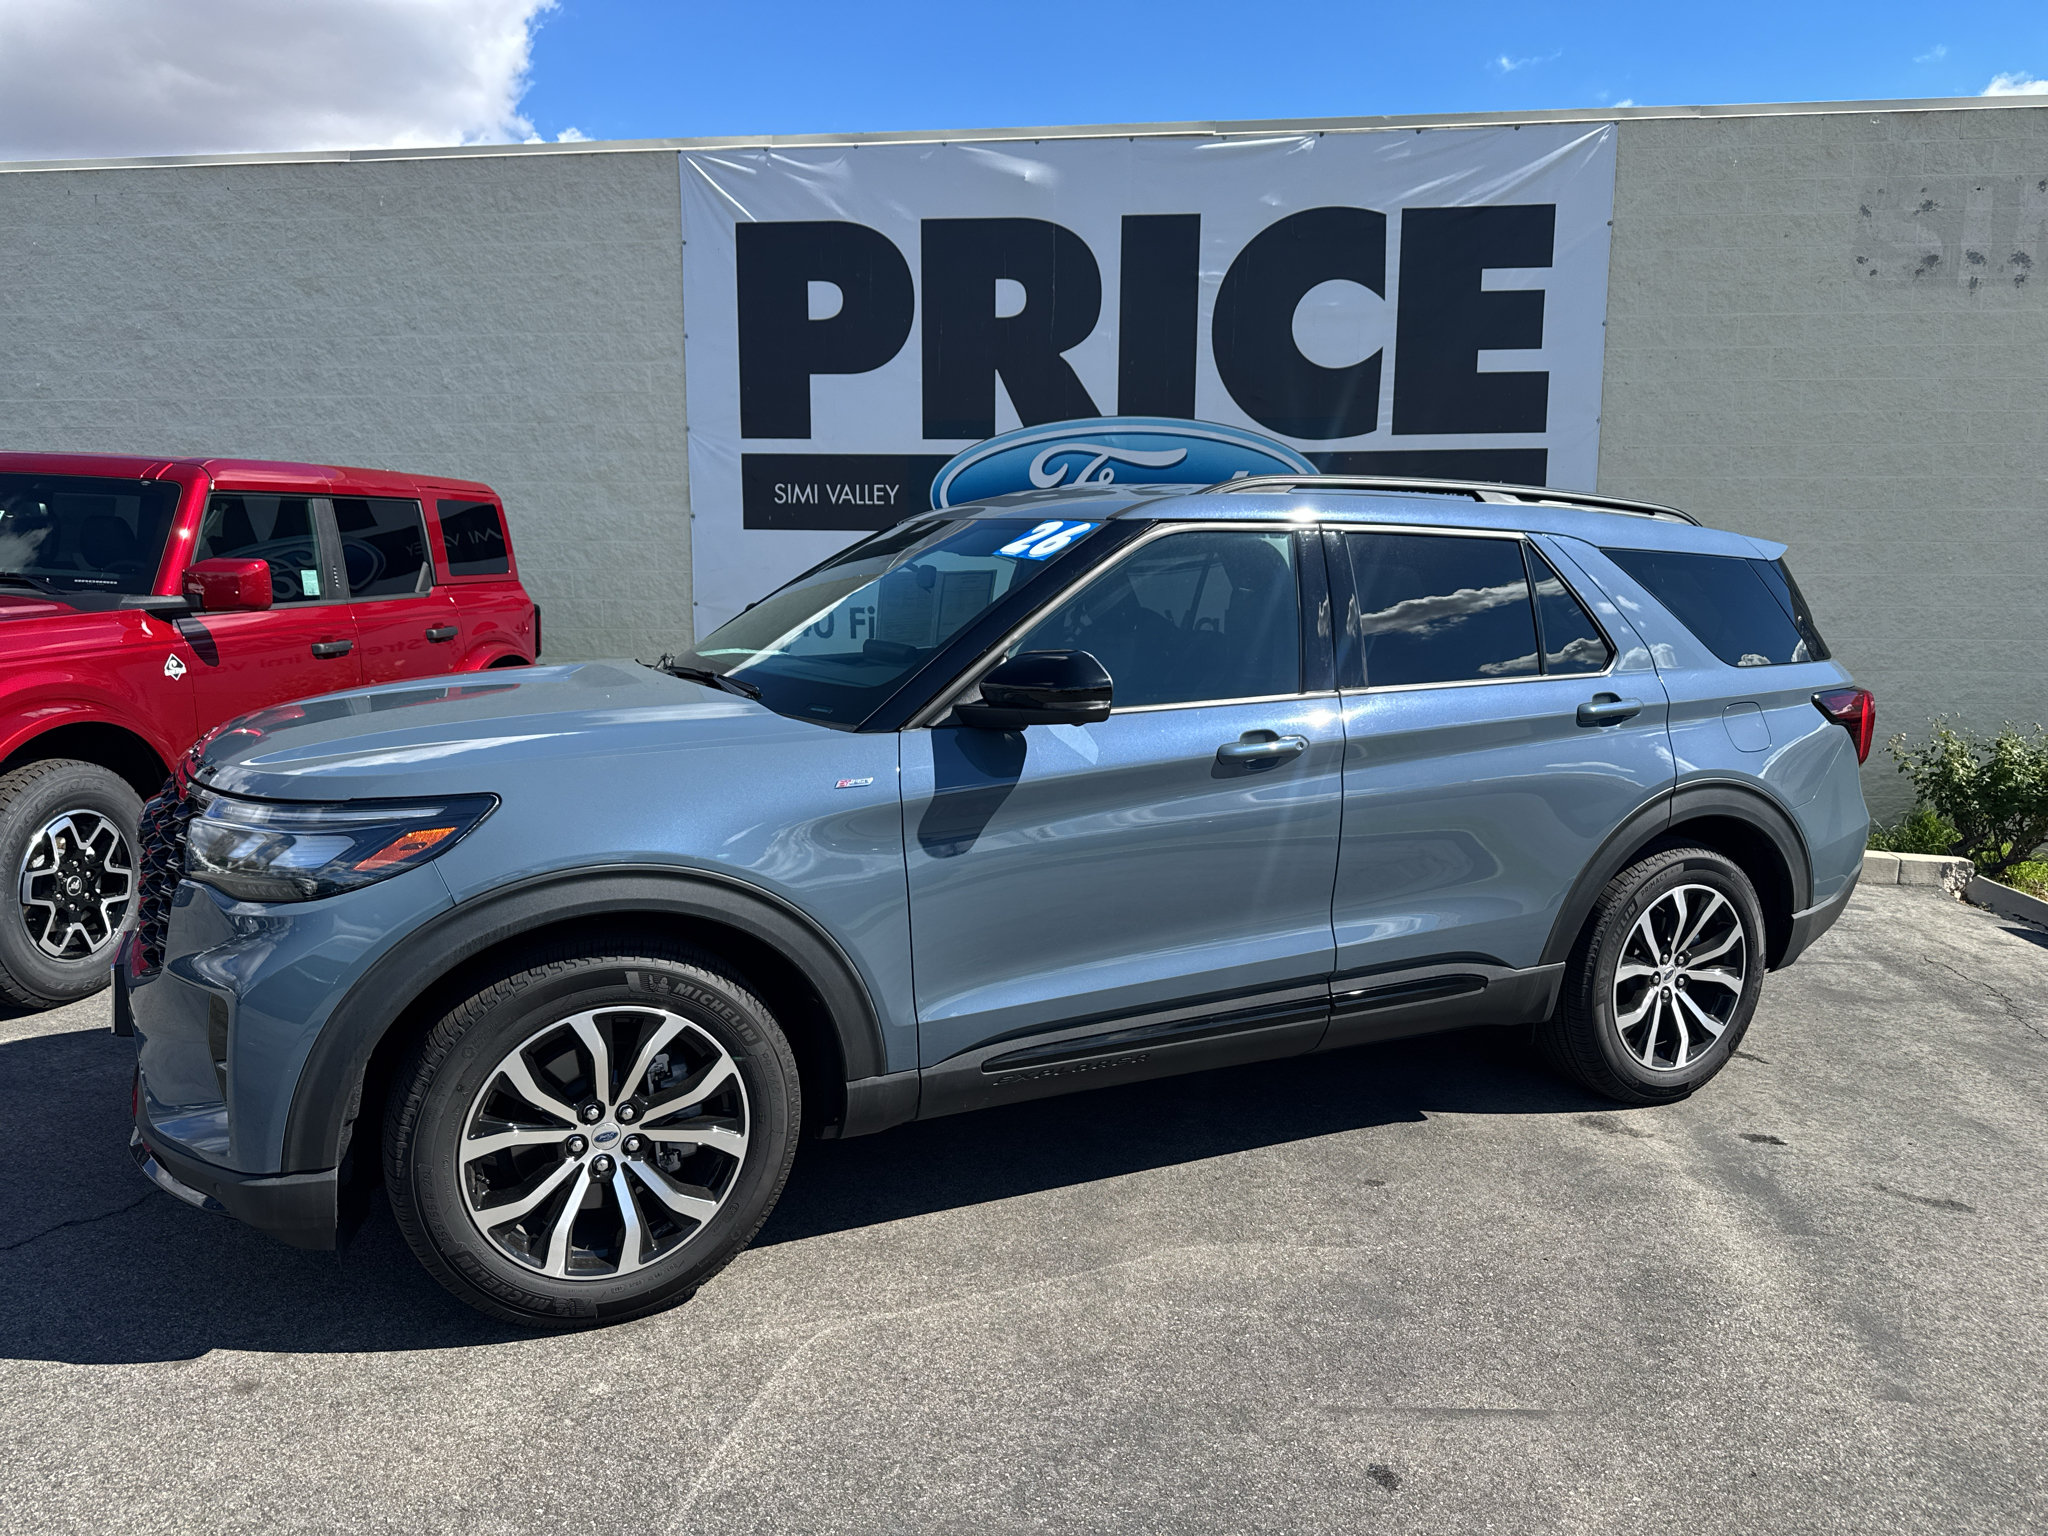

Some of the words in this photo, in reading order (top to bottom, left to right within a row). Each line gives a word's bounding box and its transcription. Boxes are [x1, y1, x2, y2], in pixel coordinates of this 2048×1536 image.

[736, 203, 1557, 440] PRICE
[773, 483, 818, 505] SIMI
[825, 483, 901, 505] VALLEY
[1000, 520, 1092, 558] 26
[673, 982, 757, 1045] MICHELIN
[455, 1252, 553, 1311] MICHELIN
